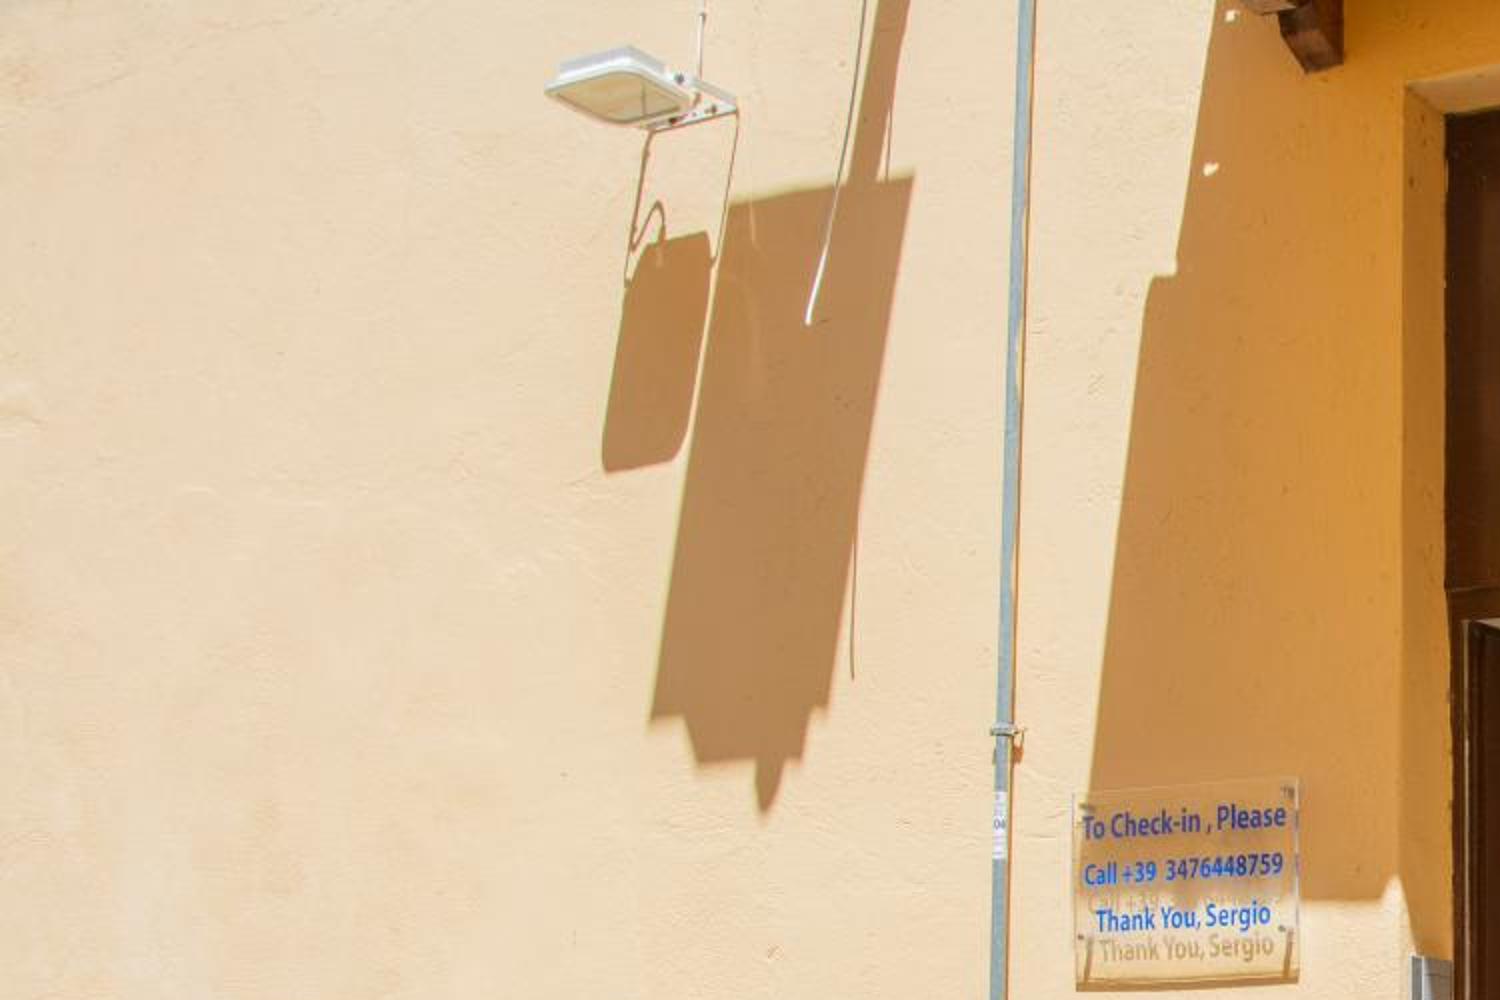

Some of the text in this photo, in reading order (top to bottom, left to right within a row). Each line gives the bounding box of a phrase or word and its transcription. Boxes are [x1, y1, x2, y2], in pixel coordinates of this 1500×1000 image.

[1083, 816, 1105, 840] To
[1111, 807, 1201, 838] Check-in
[1217, 803, 1286, 831] Please
[1085, 852, 1283, 886] Call +39 3476448759
[1096, 907, 1156, 932] Thank
[1161, 905, 1201, 930] You,
[1206, 900, 1271, 932] Sergio
[1099, 937, 1160, 962] Thank
[1209, 931, 1275, 962] Sergio
